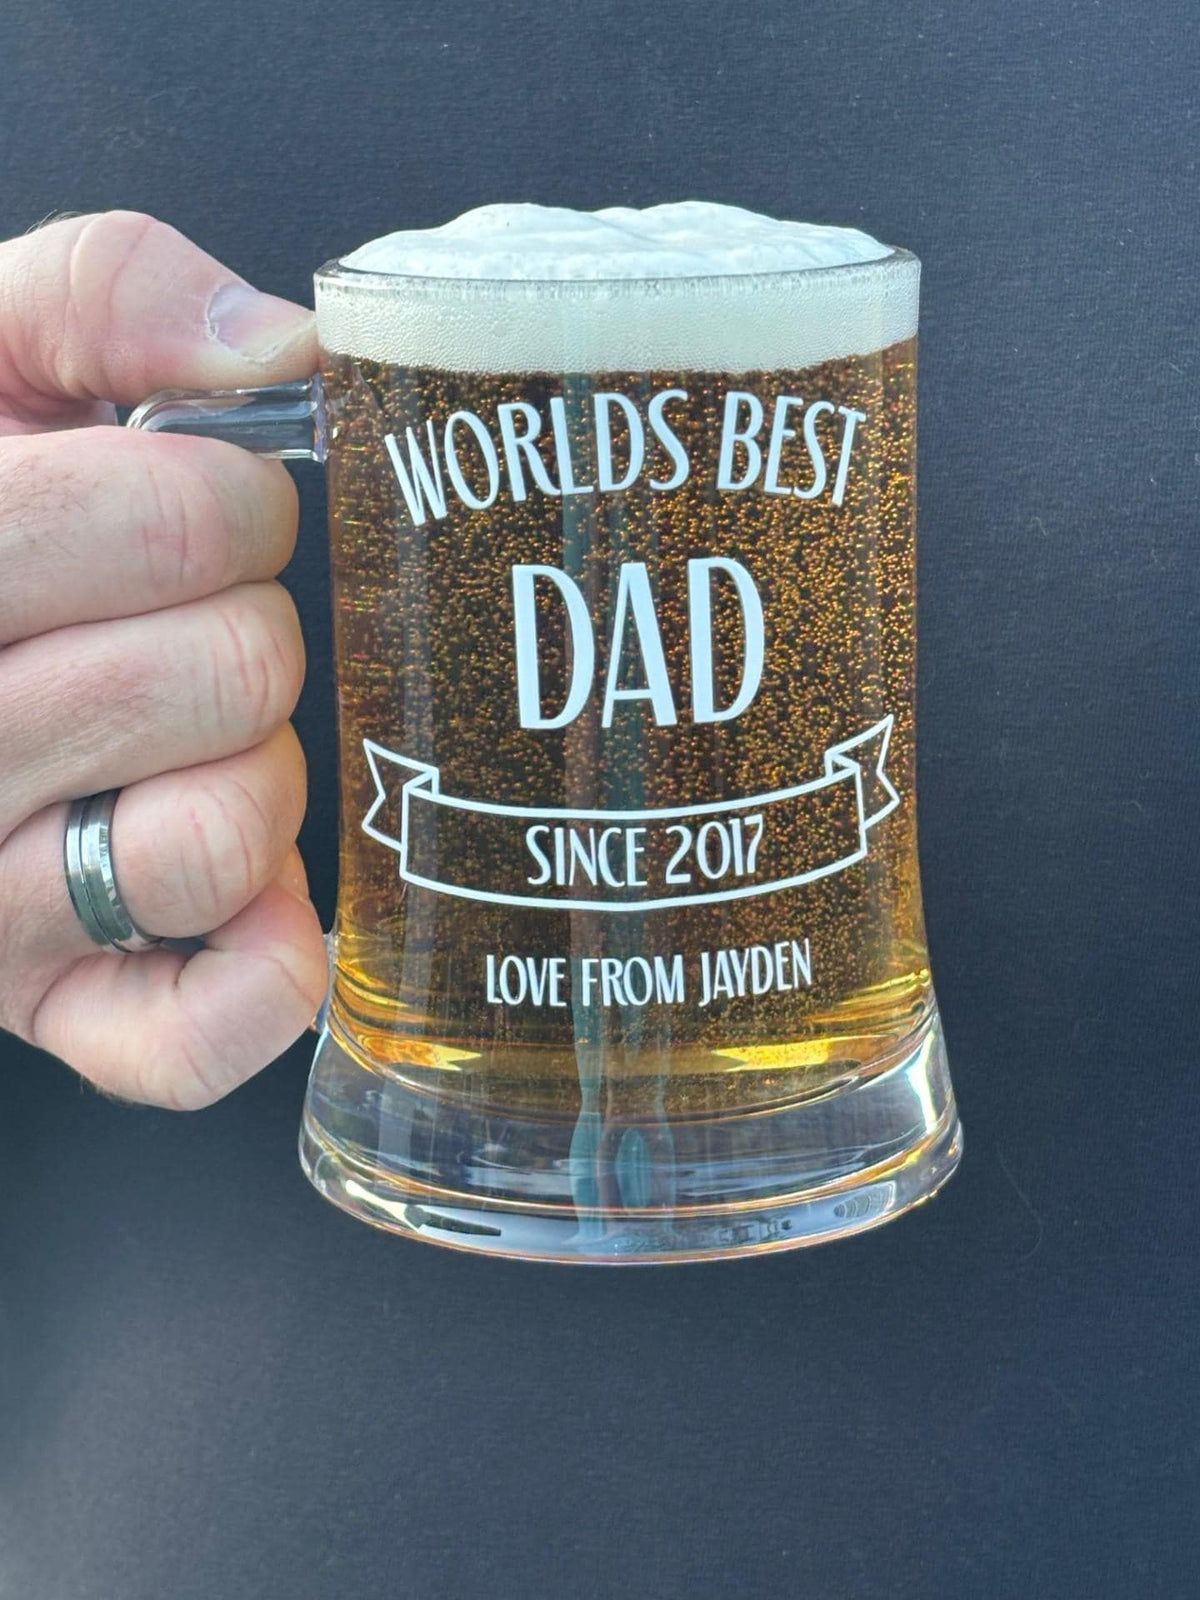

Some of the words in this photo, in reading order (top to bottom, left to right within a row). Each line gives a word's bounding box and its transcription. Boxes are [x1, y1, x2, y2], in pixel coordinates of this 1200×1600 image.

[384, 389, 690, 527] WORLDS
[716, 391, 867, 507] BEST
[511, 556, 766, 731] DAD
[525, 825, 649, 888] SINCE
[664, 813, 765, 885] 2017
[485, 954, 567, 1008] LOVE
[581, 955, 685, 1007] FROM
[698, 937, 813, 1007] JAYDEN
